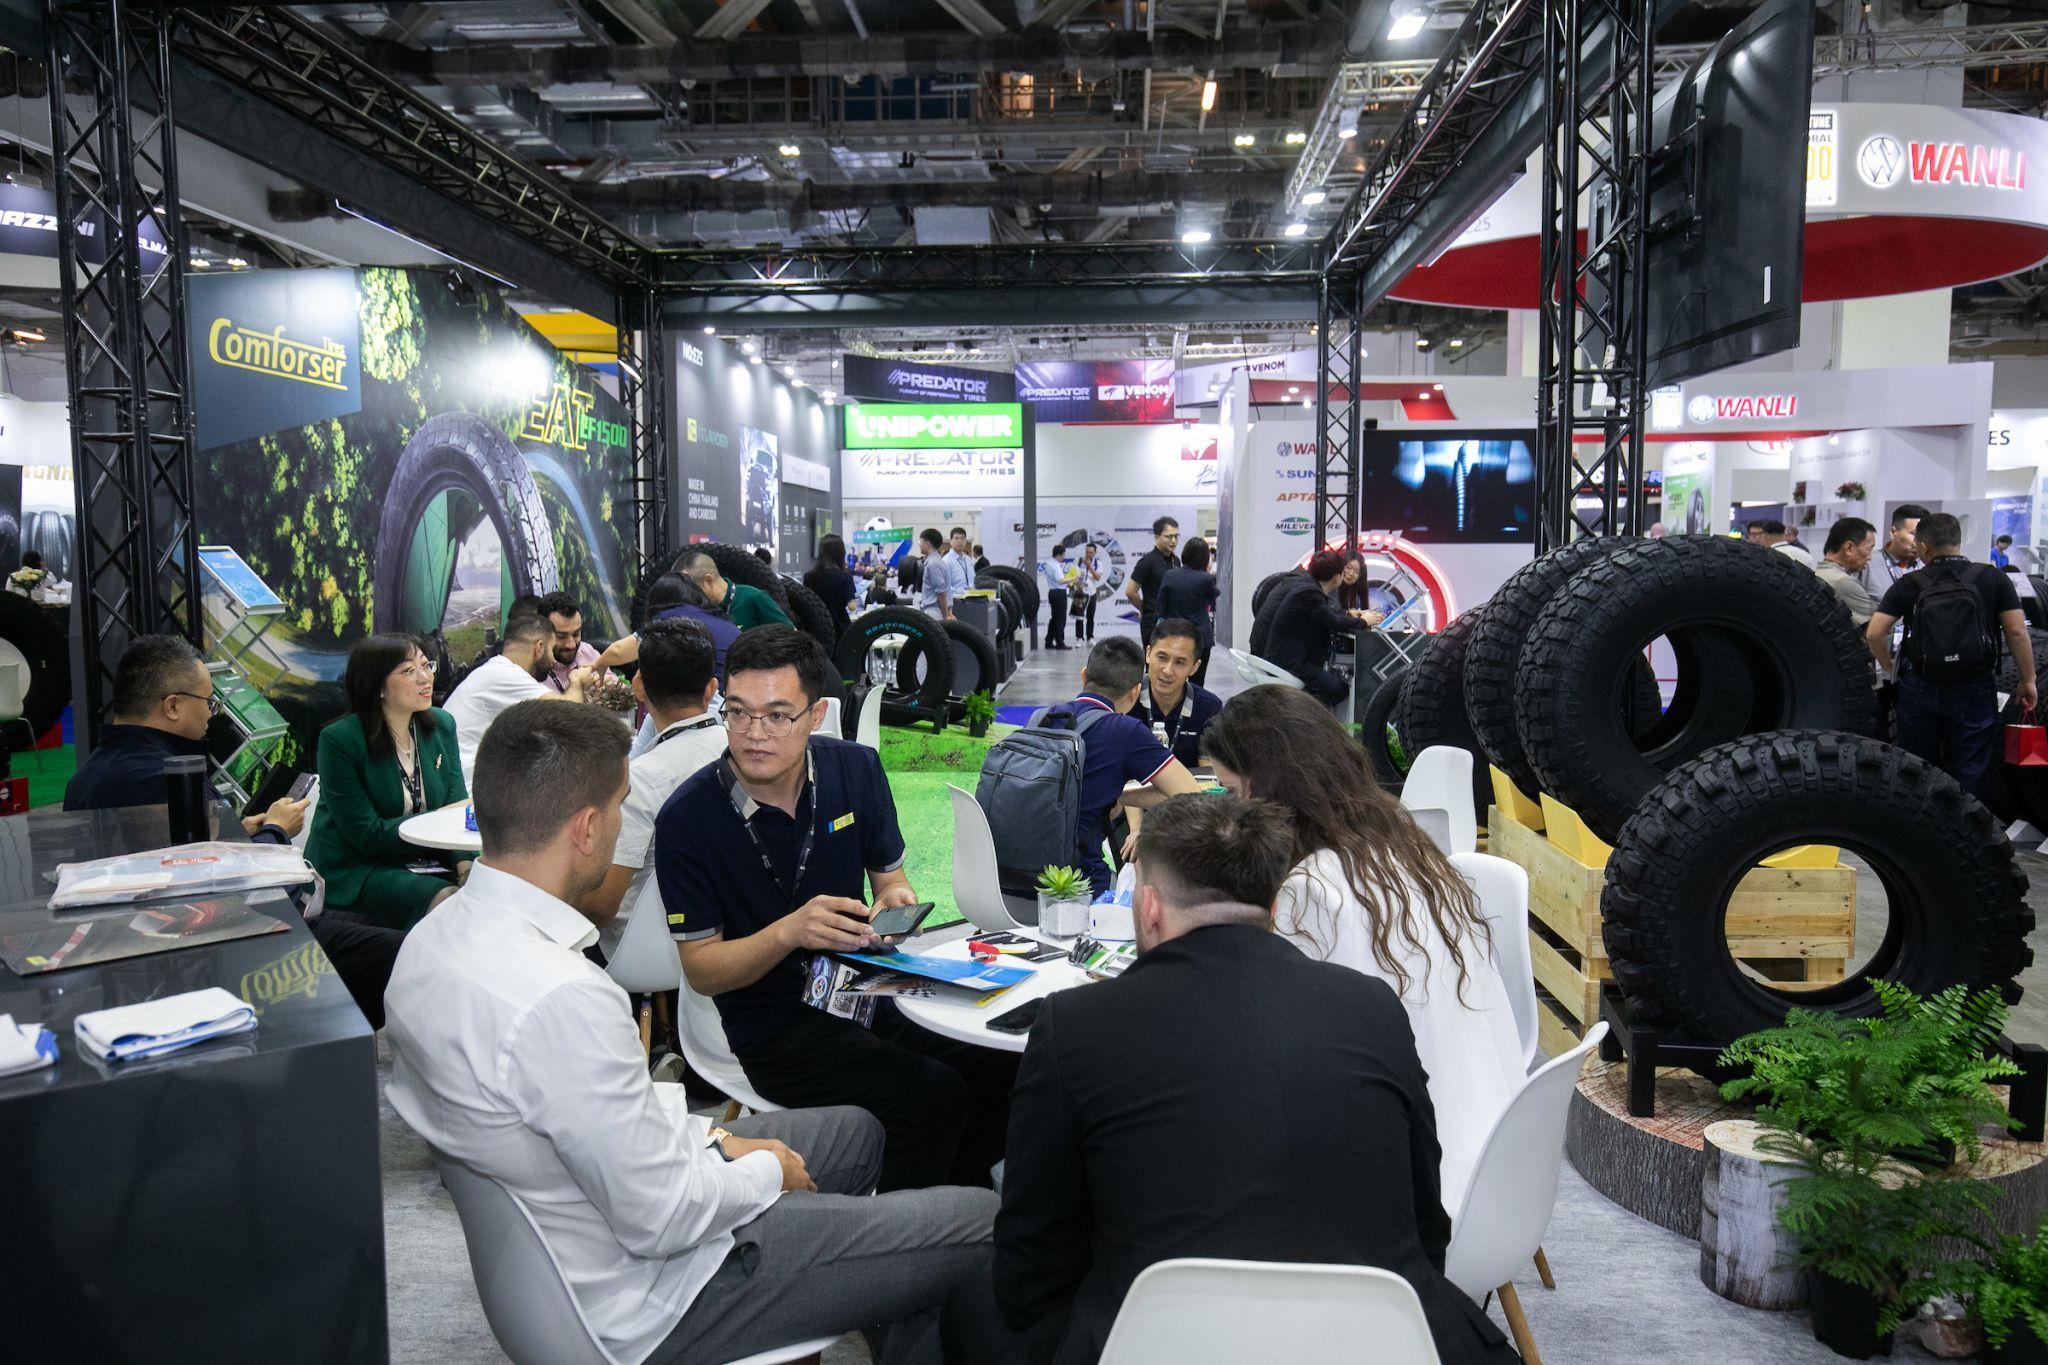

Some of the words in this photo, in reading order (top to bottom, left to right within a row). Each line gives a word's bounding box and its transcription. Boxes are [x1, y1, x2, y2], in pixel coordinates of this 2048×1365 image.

[1909, 141, 2028, 190] WANLI
[0, 209, 96, 237] AZZNI
[209, 318, 348, 390] Comforser
[1252, 361, 1285, 372] VENOM
[898, 371, 988, 394] PREDATOR
[1026, 386, 1090, 397] PREDATOR
[1125, 385, 1169, 396] VENOM
[1716, 395, 1797, 418] WANLI
[855, 414, 1014, 439] UNIPOWER
[1988, 430, 2010, 446] ES
[876, 451, 1016, 466] PREDATOR
